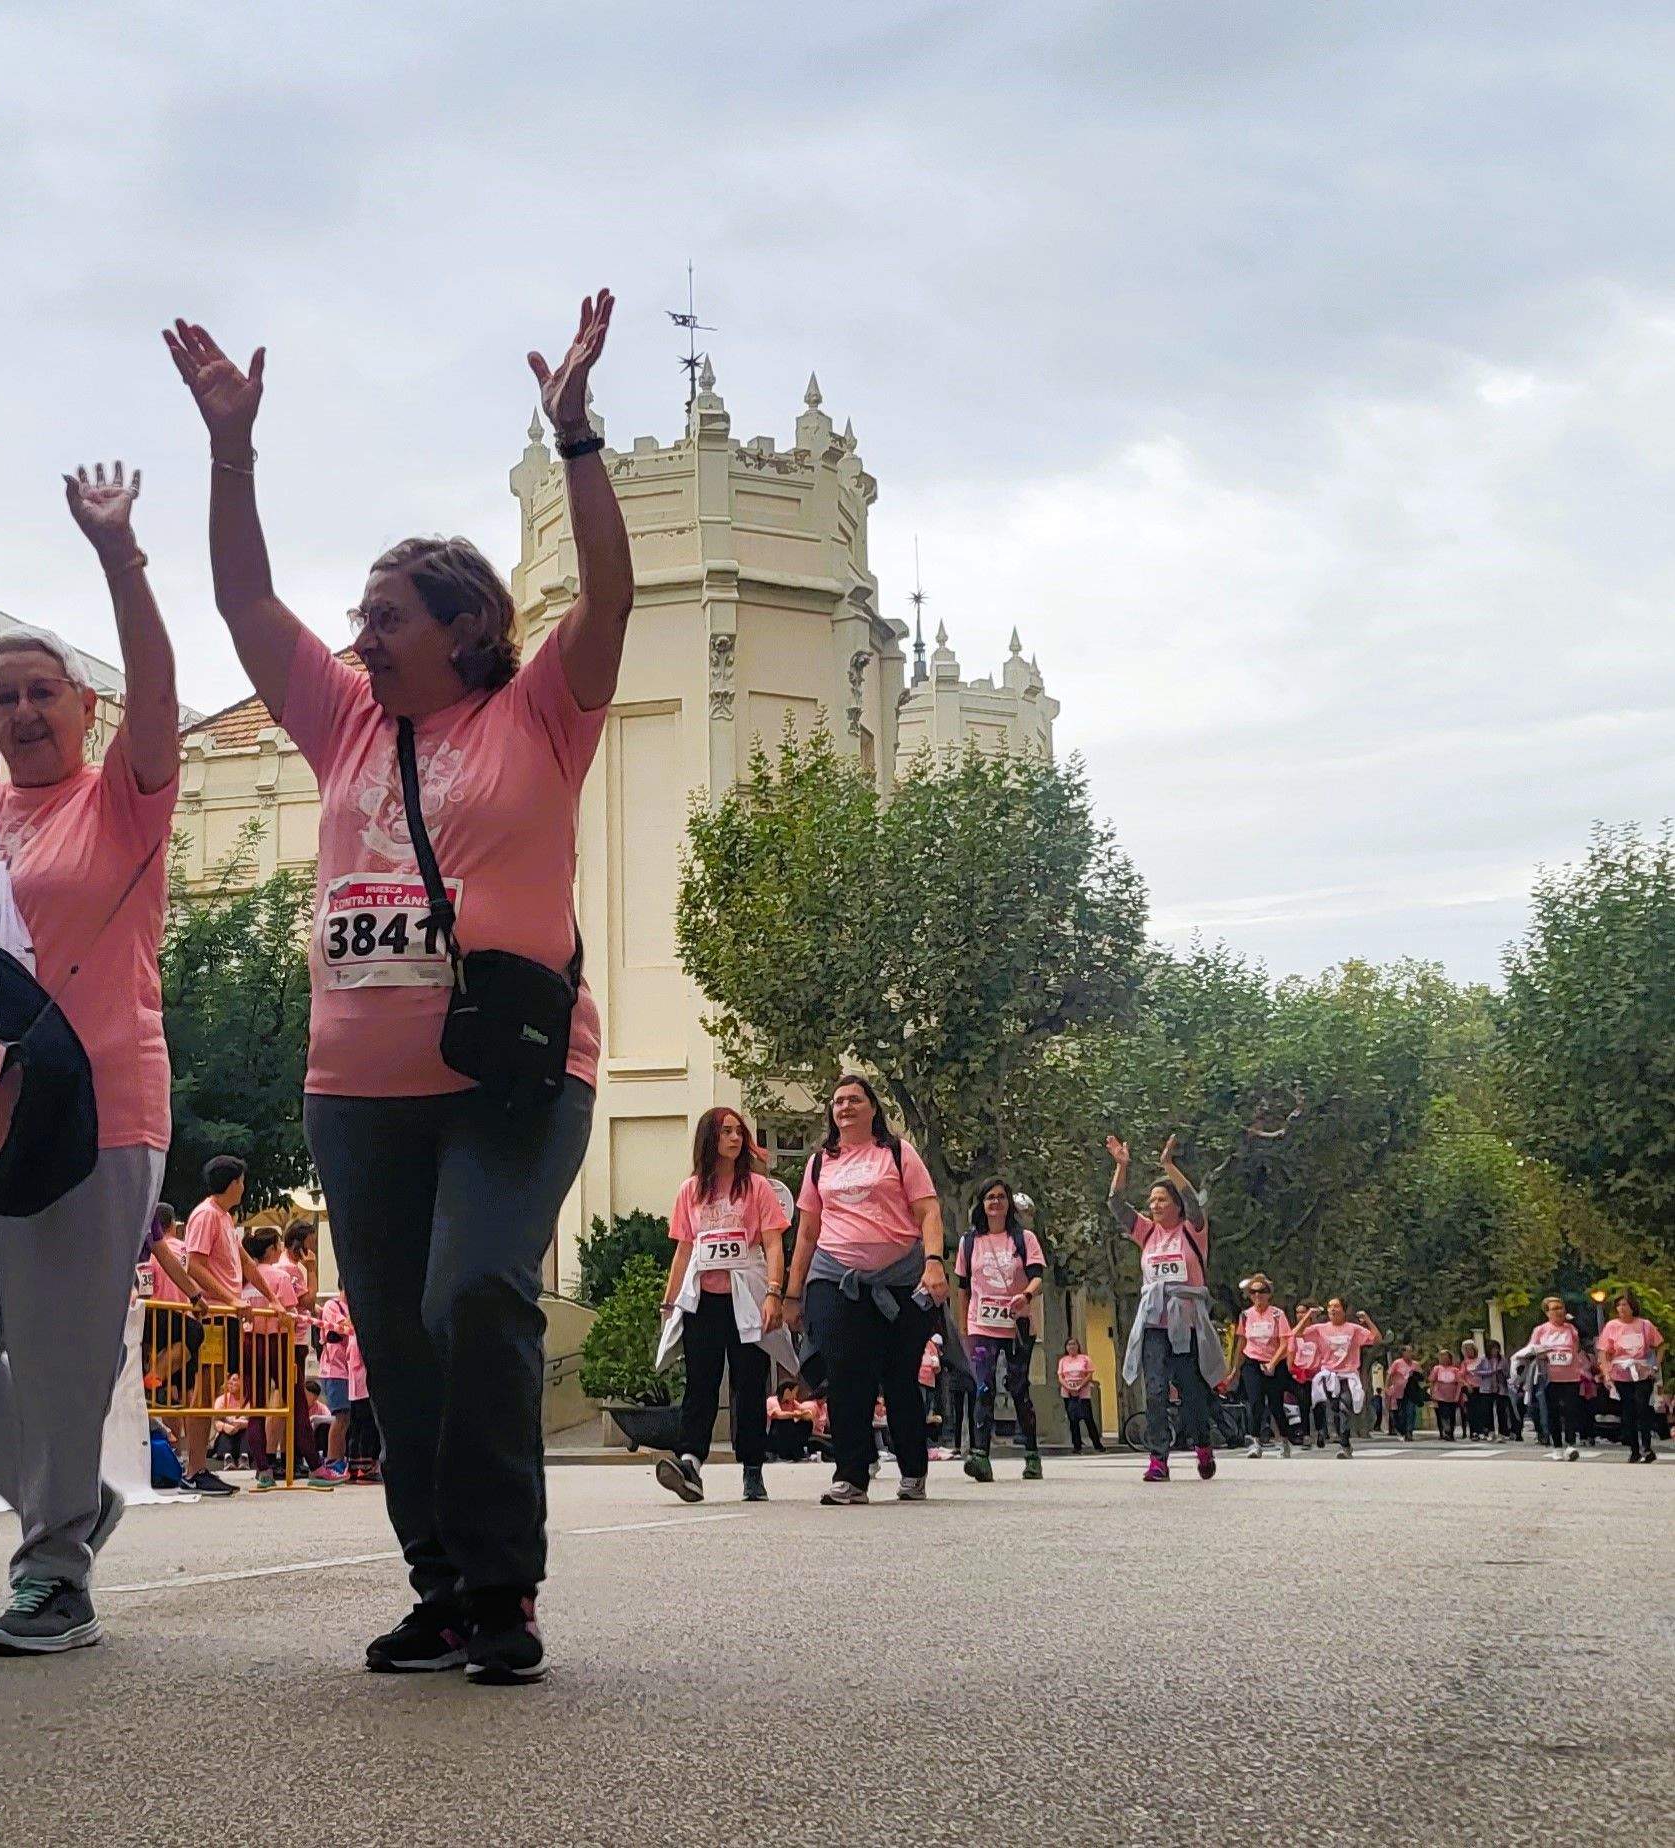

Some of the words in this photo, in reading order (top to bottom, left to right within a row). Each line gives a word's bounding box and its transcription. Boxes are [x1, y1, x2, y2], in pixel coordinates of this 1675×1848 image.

[376, 895, 391, 905] EL
[328, 912, 438, 960] 3841
[707, 1242, 741, 1259] 759
[1152, 1262, 1180, 1276] 760
